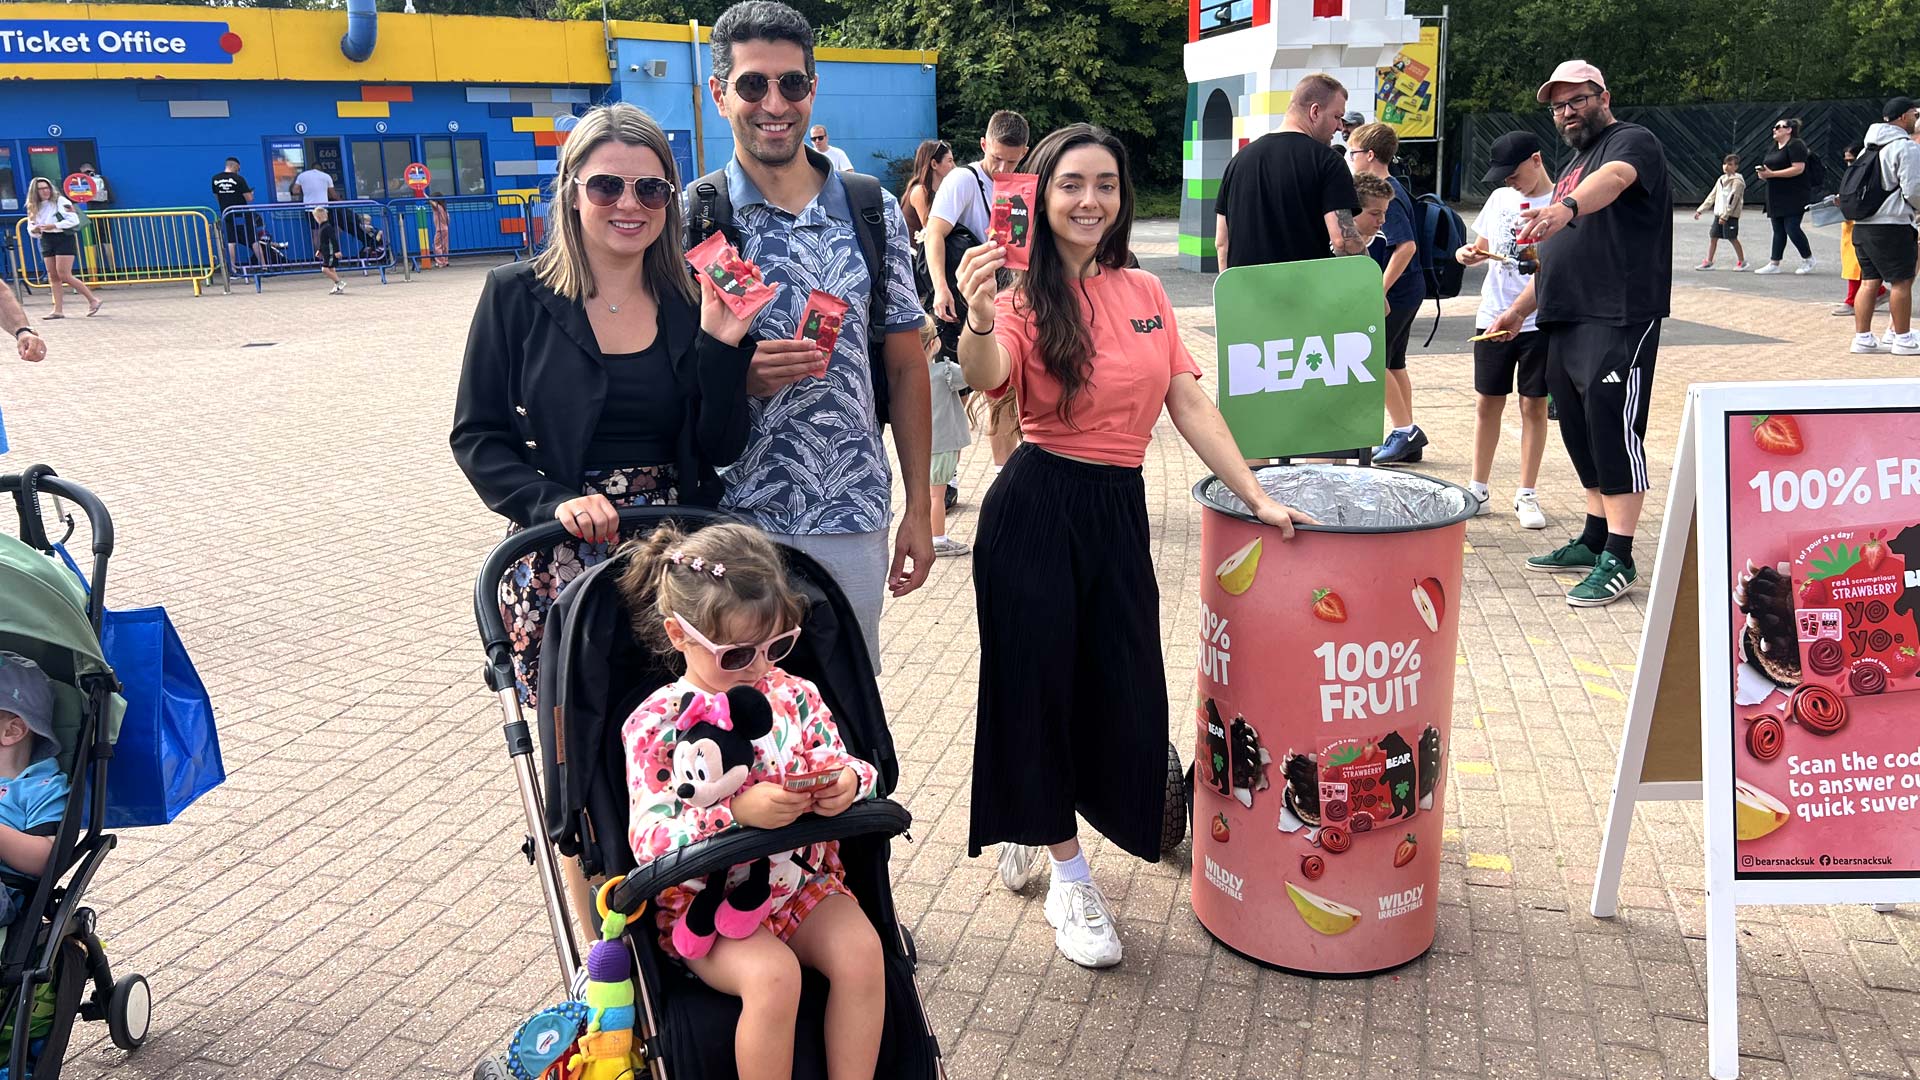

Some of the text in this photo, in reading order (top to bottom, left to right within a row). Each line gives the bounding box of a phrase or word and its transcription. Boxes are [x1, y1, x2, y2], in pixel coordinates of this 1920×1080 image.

[0, 30, 187, 53] Ticket Office
[1011, 208, 1027, 216] BEAR
[1748, 466, 1872, 513] 100%
[1799, 550, 1807, 560] of
[1806, 538, 1822, 553] your
[1822, 534, 1829, 543] 5
[1837, 531, 1854, 539] day!
[1831, 575, 1896, 587] real scrumptious
[1832, 582, 1898, 600] STRAWBERRY
[1821, 612, 1838, 620] FREE
[1313, 639, 1421, 682] 100%
[1320, 671, 1421, 722] FRUIT
[1208, 721, 1225, 739] BEAR
[1386, 752, 1411, 769] BEAR
[1787, 755, 1836, 775] Scan
[1841, 751, 1878, 771] the
[1342, 767, 1382, 778] STRAWBERRY
[1789, 779, 1814, 797] to
[1819, 774, 1895, 795] answer
[1796, 794, 1919, 822] quick suver
[1205, 854, 1243, 891] WILDLY
[1755, 856, 1892, 866] bearsnacksuk bearsnacksuk
[1205, 869, 1243, 901] IRRESISTIBLE
[1378, 883, 1424, 910] WILDLY
[1378, 898, 1423, 920] IRRESISTIBLE
